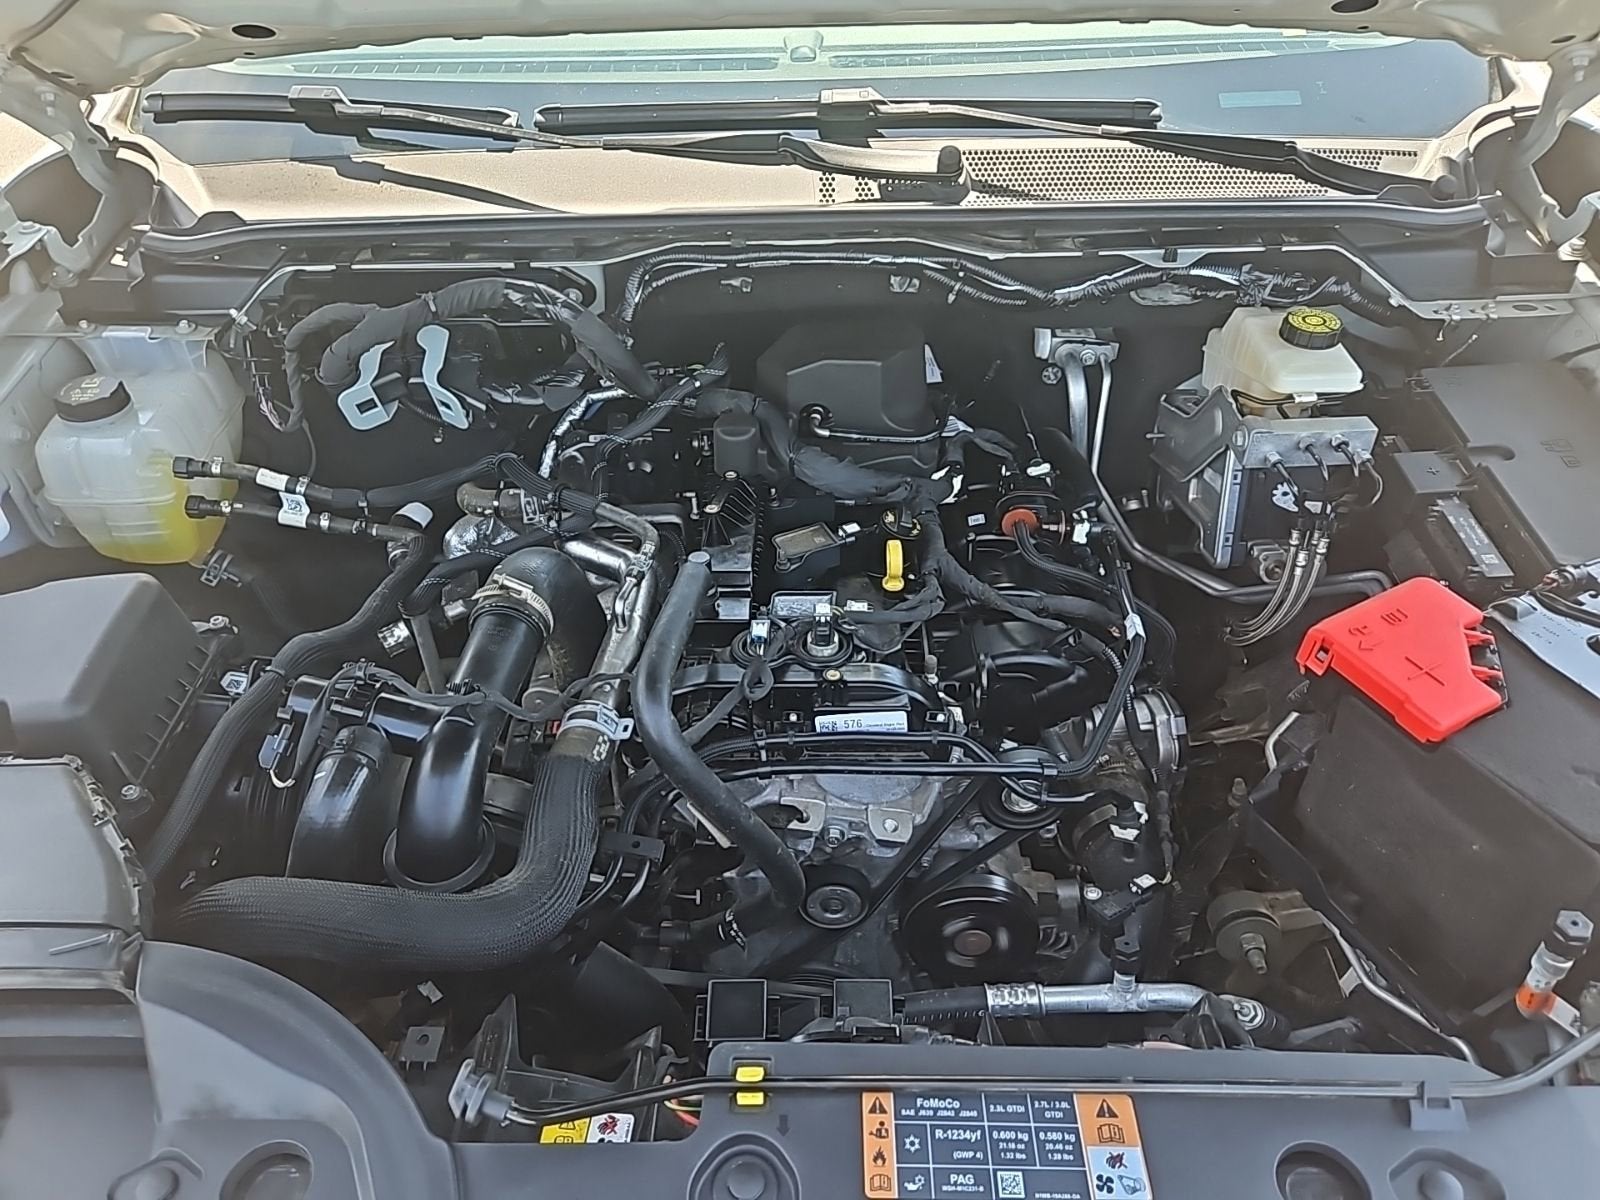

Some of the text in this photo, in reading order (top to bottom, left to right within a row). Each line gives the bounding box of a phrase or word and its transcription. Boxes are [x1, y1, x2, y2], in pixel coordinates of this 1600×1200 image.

[843, 718, 863, 729] 576
[916, 1097, 961, 1109] FoMoCo
[989, 1104, 1025, 1113] 2.3L GTDI
[901, 1108, 915, 1116] SAE
[1044, 1110, 1064, 1118] GTDI
[935, 1128, 982, 1142] R-1234yf
[992, 1130, 1029, 1141] 0.600 kg
[1064, 1131, 1076, 1142] kg
[950, 1174, 975, 1185] PAG
